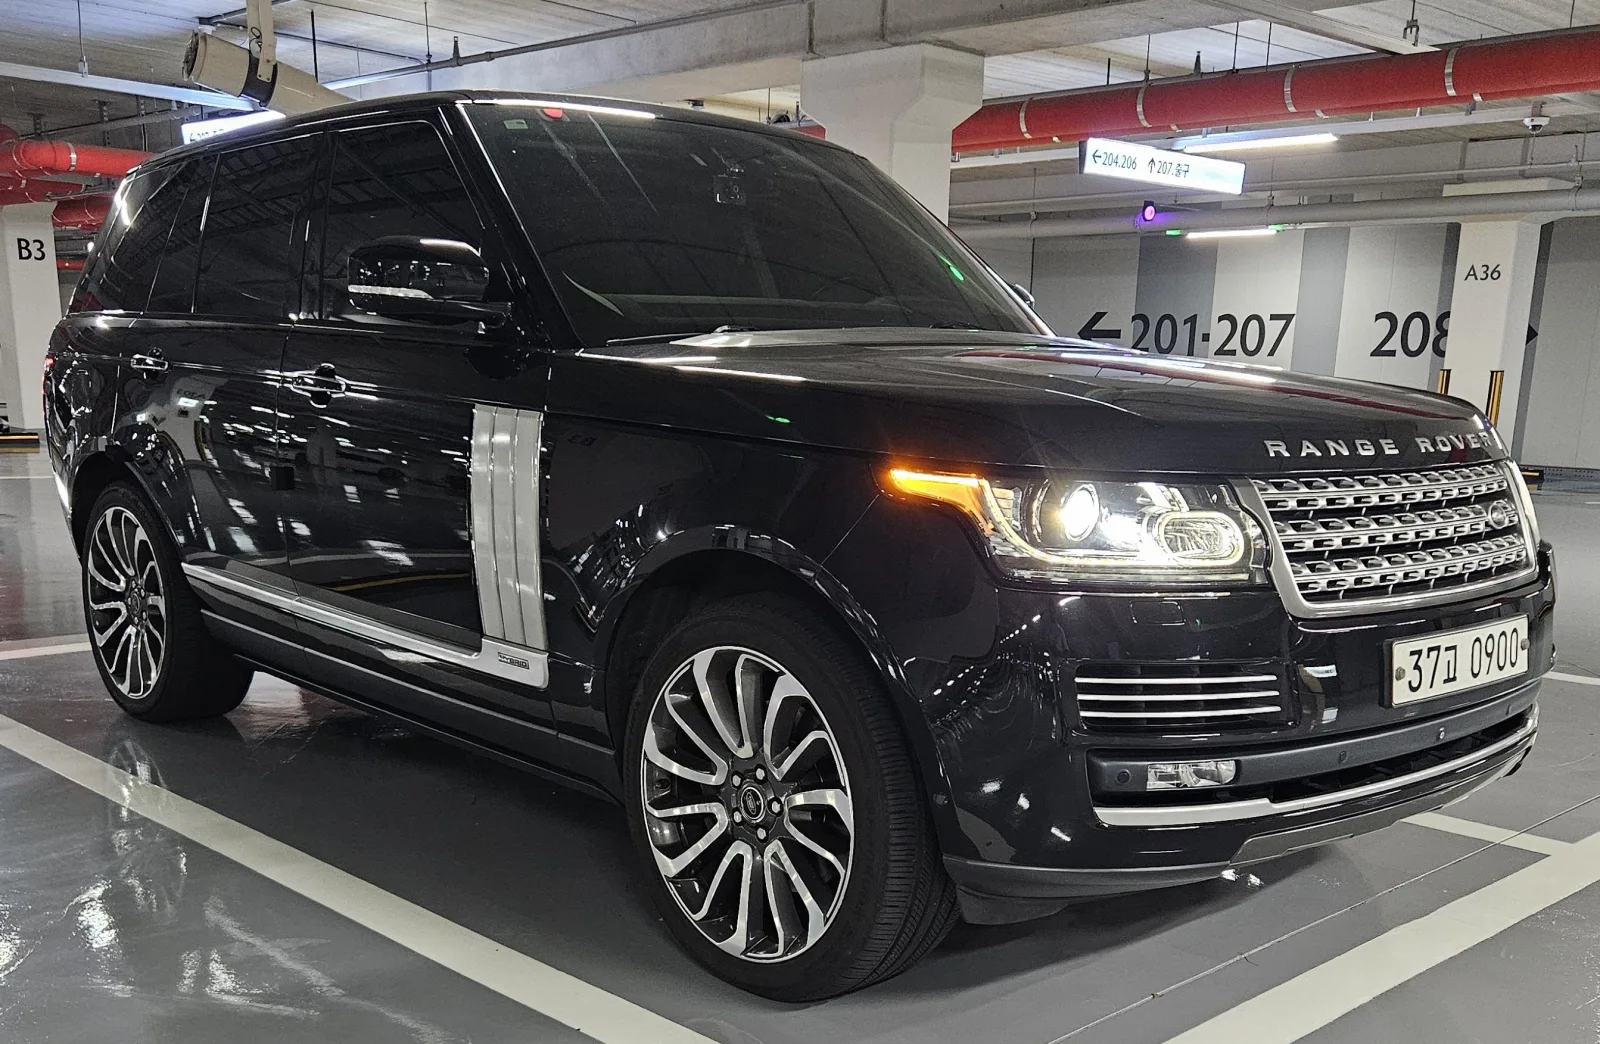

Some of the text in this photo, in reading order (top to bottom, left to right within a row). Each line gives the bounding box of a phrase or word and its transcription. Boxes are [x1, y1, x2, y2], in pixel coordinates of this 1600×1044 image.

[17, 238, 45, 261] B3
[1464, 264, 1502, 281] A36
[1263, 431, 1493, 457] RANGE ROVER
[1471, 627, 1519, 679] 0900
